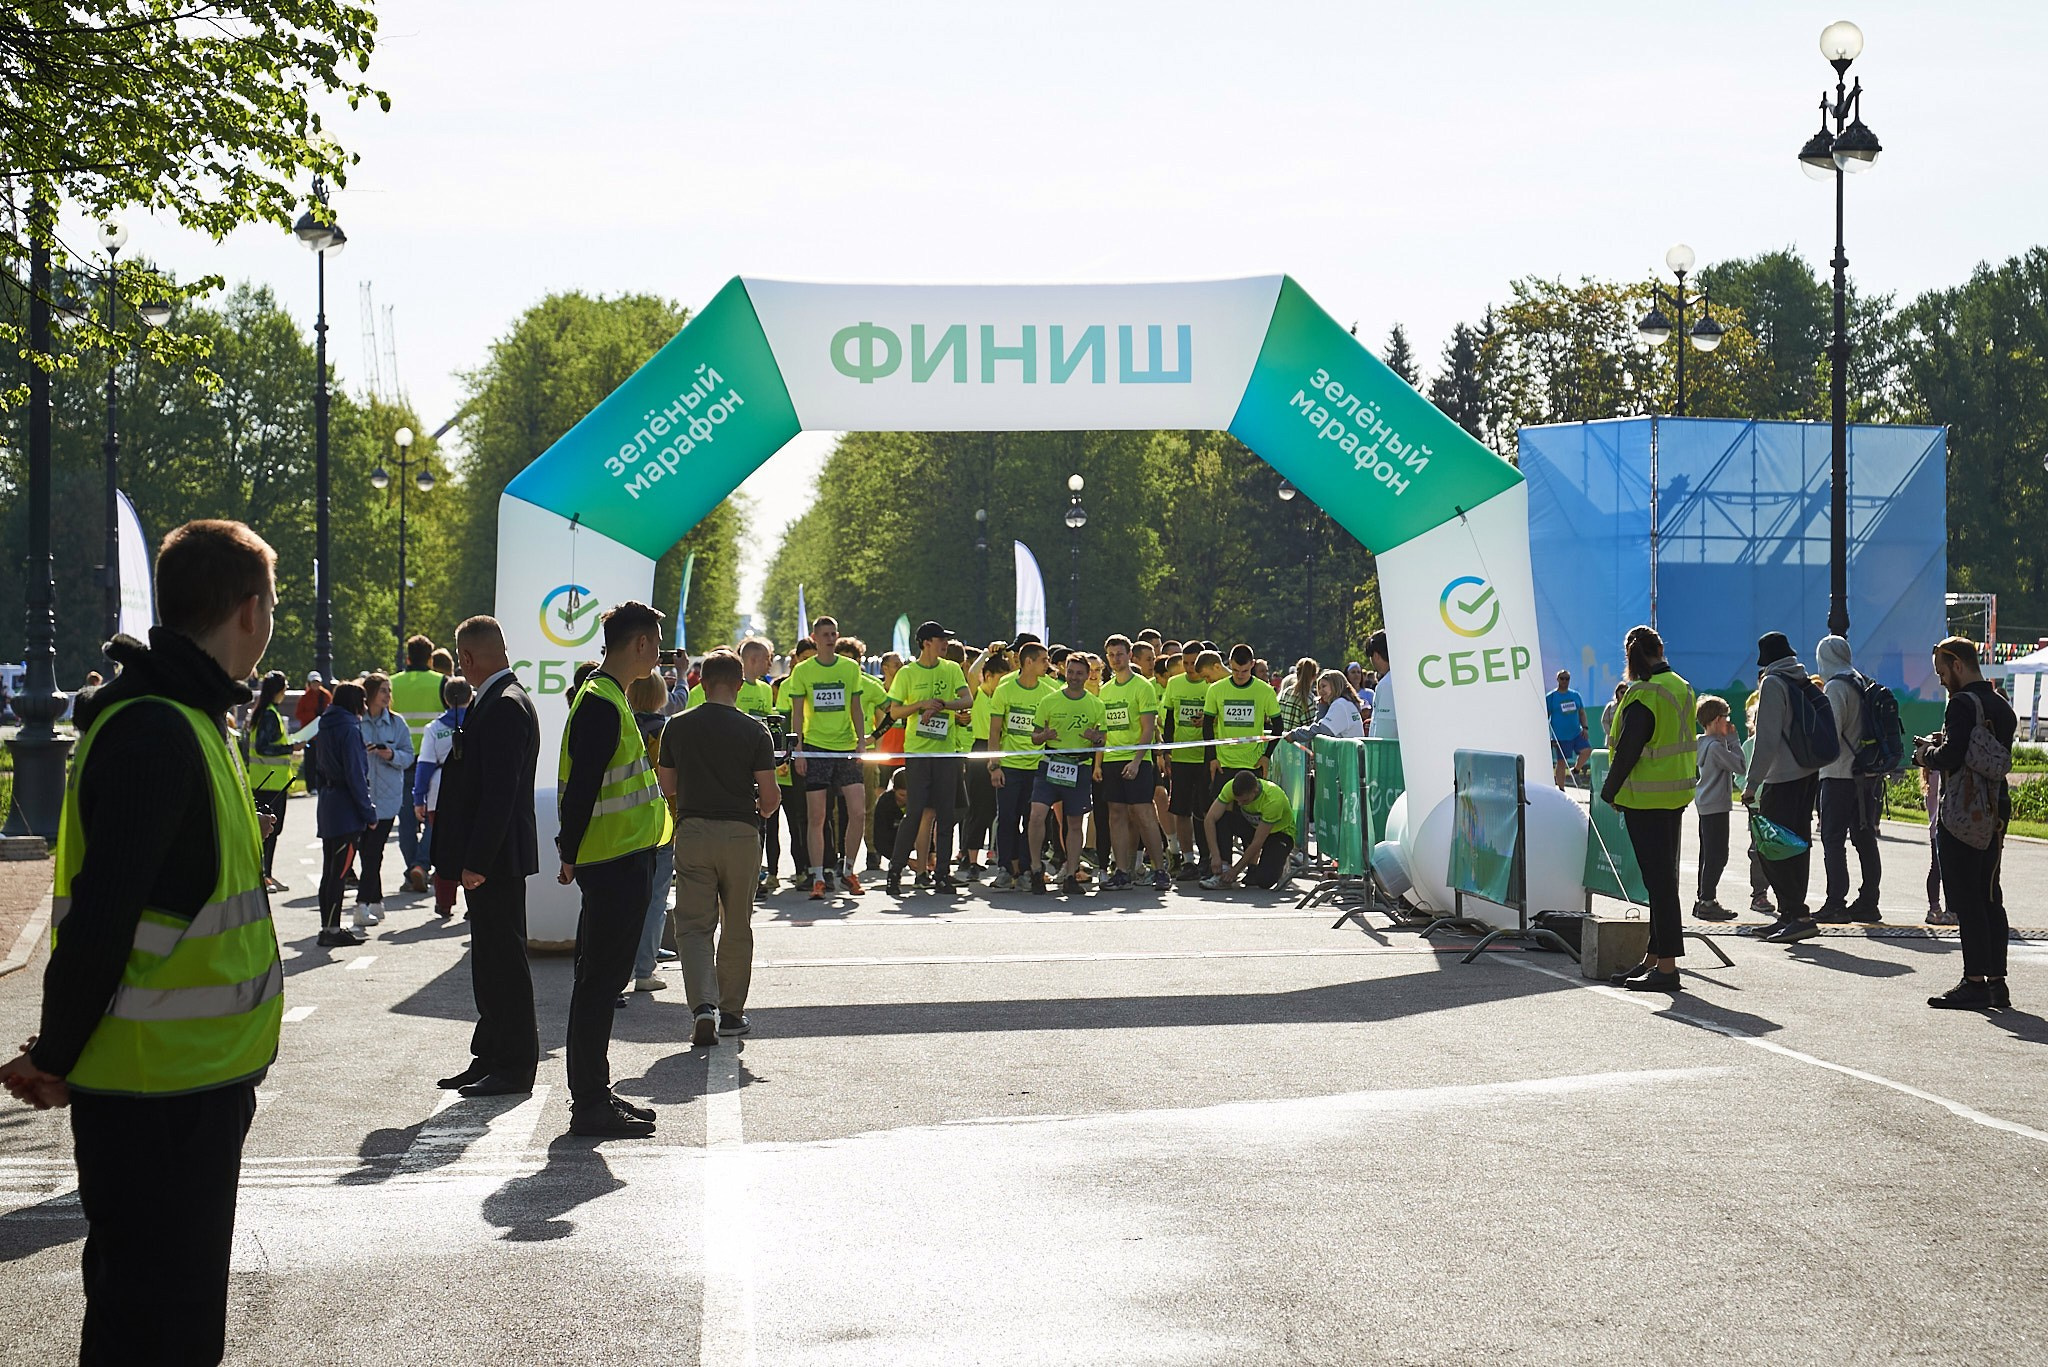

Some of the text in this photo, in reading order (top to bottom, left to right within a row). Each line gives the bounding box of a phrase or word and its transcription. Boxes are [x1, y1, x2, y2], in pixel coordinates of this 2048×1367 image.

[830, 321, 1192, 384] ФИНИШ
[604, 363, 724, 477] зелёный
[624, 389, 745, 500] марафон
[1289, 389, 1411, 497] марафон
[1309, 368, 1433, 475] зелёный
[816, 692, 842, 700] 42311
[1418, 646, 1531, 689] СБЕР
[1050, 764, 1076, 776] 42319
